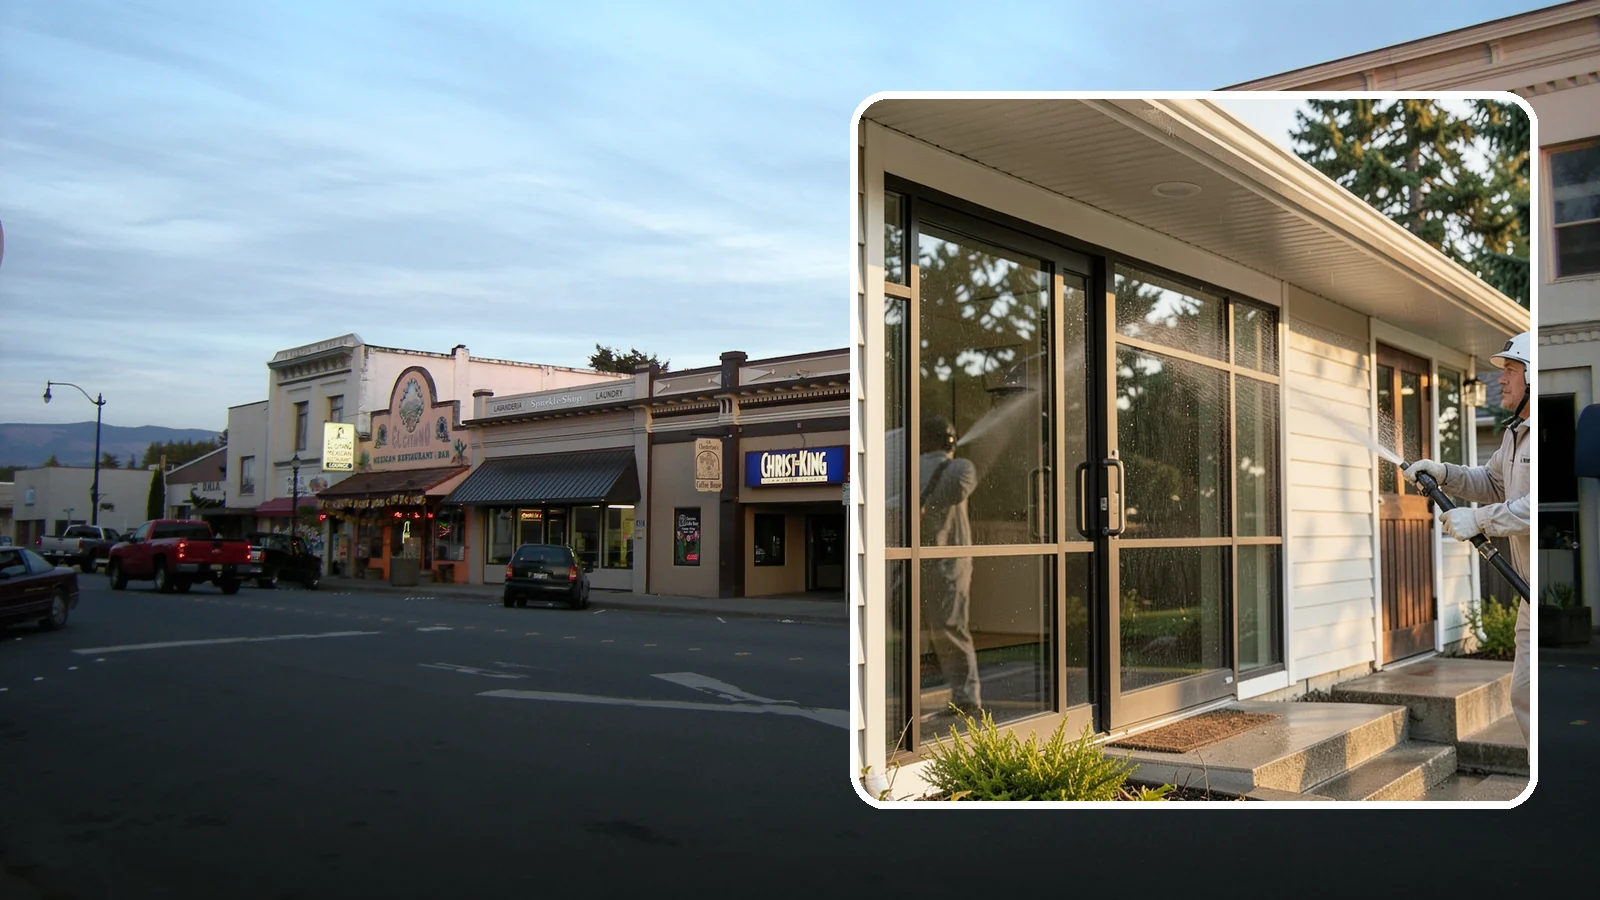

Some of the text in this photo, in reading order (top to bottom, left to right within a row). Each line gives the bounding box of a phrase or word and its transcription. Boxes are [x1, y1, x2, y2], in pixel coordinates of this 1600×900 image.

[596, 389, 624, 400] LAUNDRY
[494, 402, 522, 412] LAVANDERIA
[530, 394, 583, 409] Sparkle Shop
[374, 455, 396, 464] MEXICAN
[397, 451, 434, 462] RESTAURANT
[438, 450, 450, 459] BAR
[761, 450, 828, 478] CHRIST KING
[696, 480, 722, 489] Coffee House
